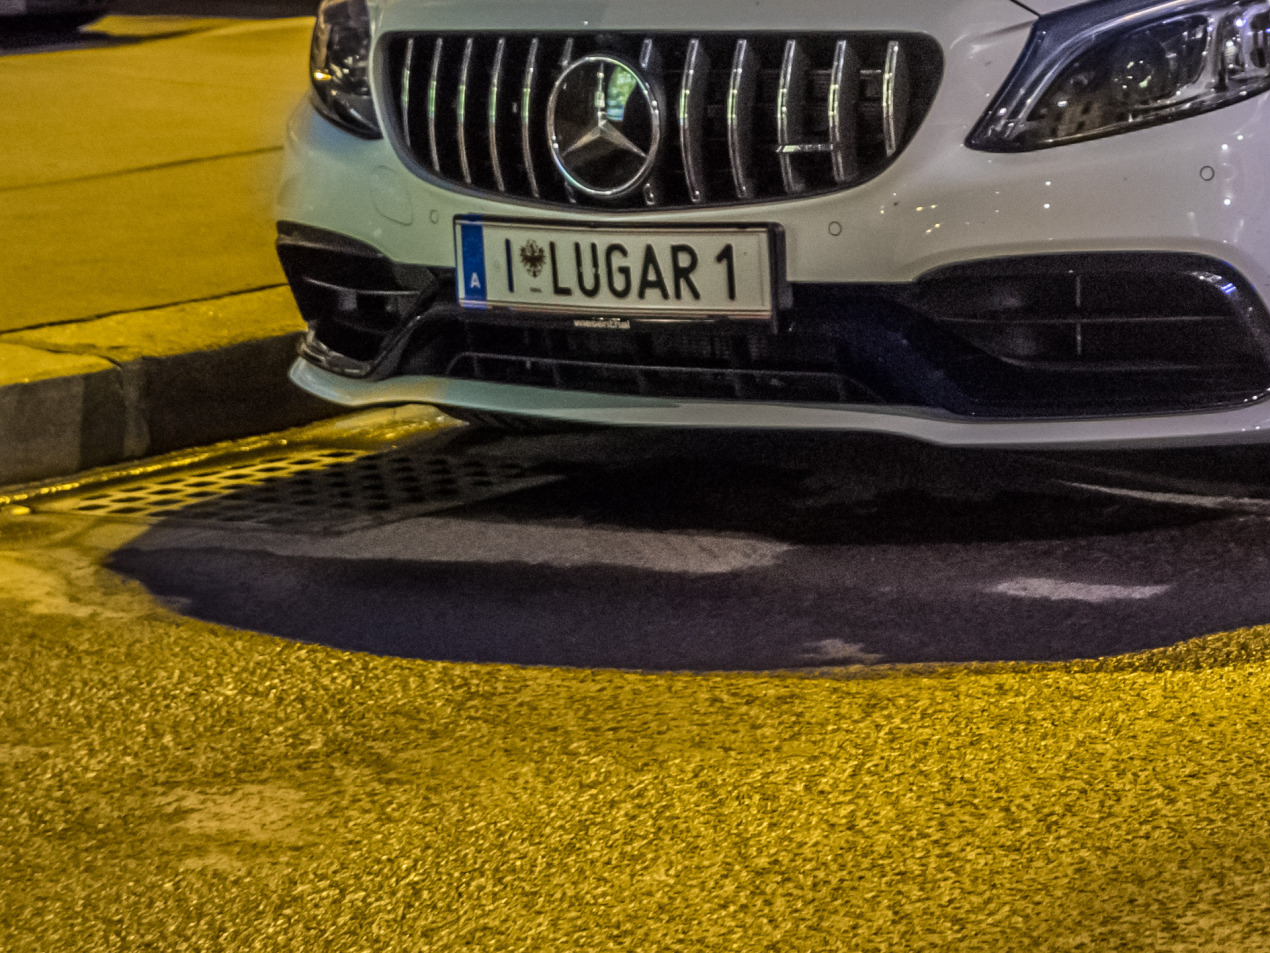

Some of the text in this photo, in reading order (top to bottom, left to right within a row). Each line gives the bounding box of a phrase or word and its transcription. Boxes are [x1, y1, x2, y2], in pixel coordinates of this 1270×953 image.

[470, 272, 481, 288] A
[549, 241, 701, 300] LUGAR
[715, 243, 736, 300] 1
